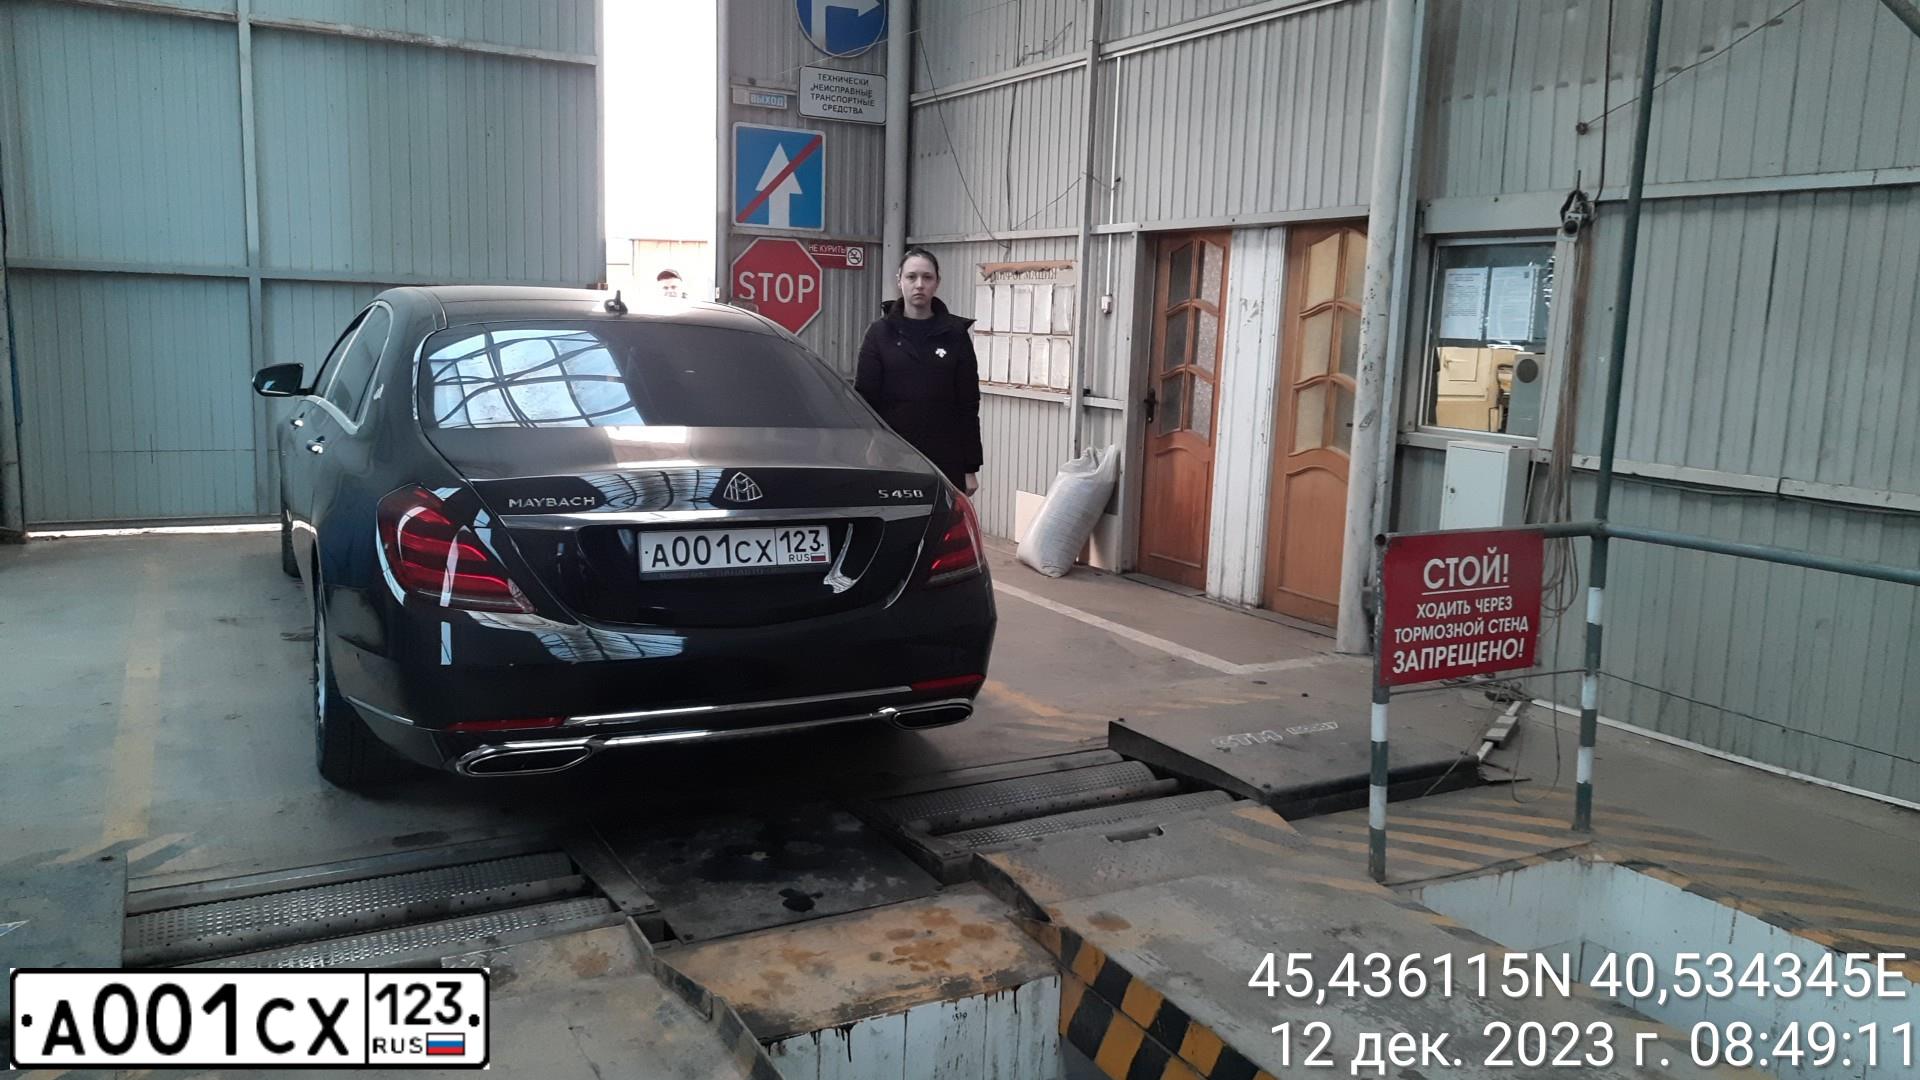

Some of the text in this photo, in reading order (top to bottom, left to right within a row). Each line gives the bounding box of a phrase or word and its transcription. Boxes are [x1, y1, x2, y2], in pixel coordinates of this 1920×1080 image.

[817, 73, 869, 86] ТЕХНИЧЕСКИ
[751, 93, 785, 106] ВЫХОД
[810, 93, 875, 107] ТРАНСПОРТНЫЕ
[822, 104, 863, 115] СРЕДСТВА
[809, 244, 846, 254] НЕ КУРИТЬ
[738, 271, 815, 304] STOP
[878, 489, 924, 499] S 450
[508, 495, 596, 509] MAYBACH
[779, 529, 821, 553] 123
[787, 553, 811, 563] RUS
[1423, 546, 1509, 589] СТОЙ!
[1416, 596, 1513, 619] ХОДИТЬ ЧЕРЕЗ
[1394, 616, 1529, 644] ТОРМОЗНОЙ СТЕНД
[1392, 638, 1525, 674] ЗАПРЕЩЕНО!
